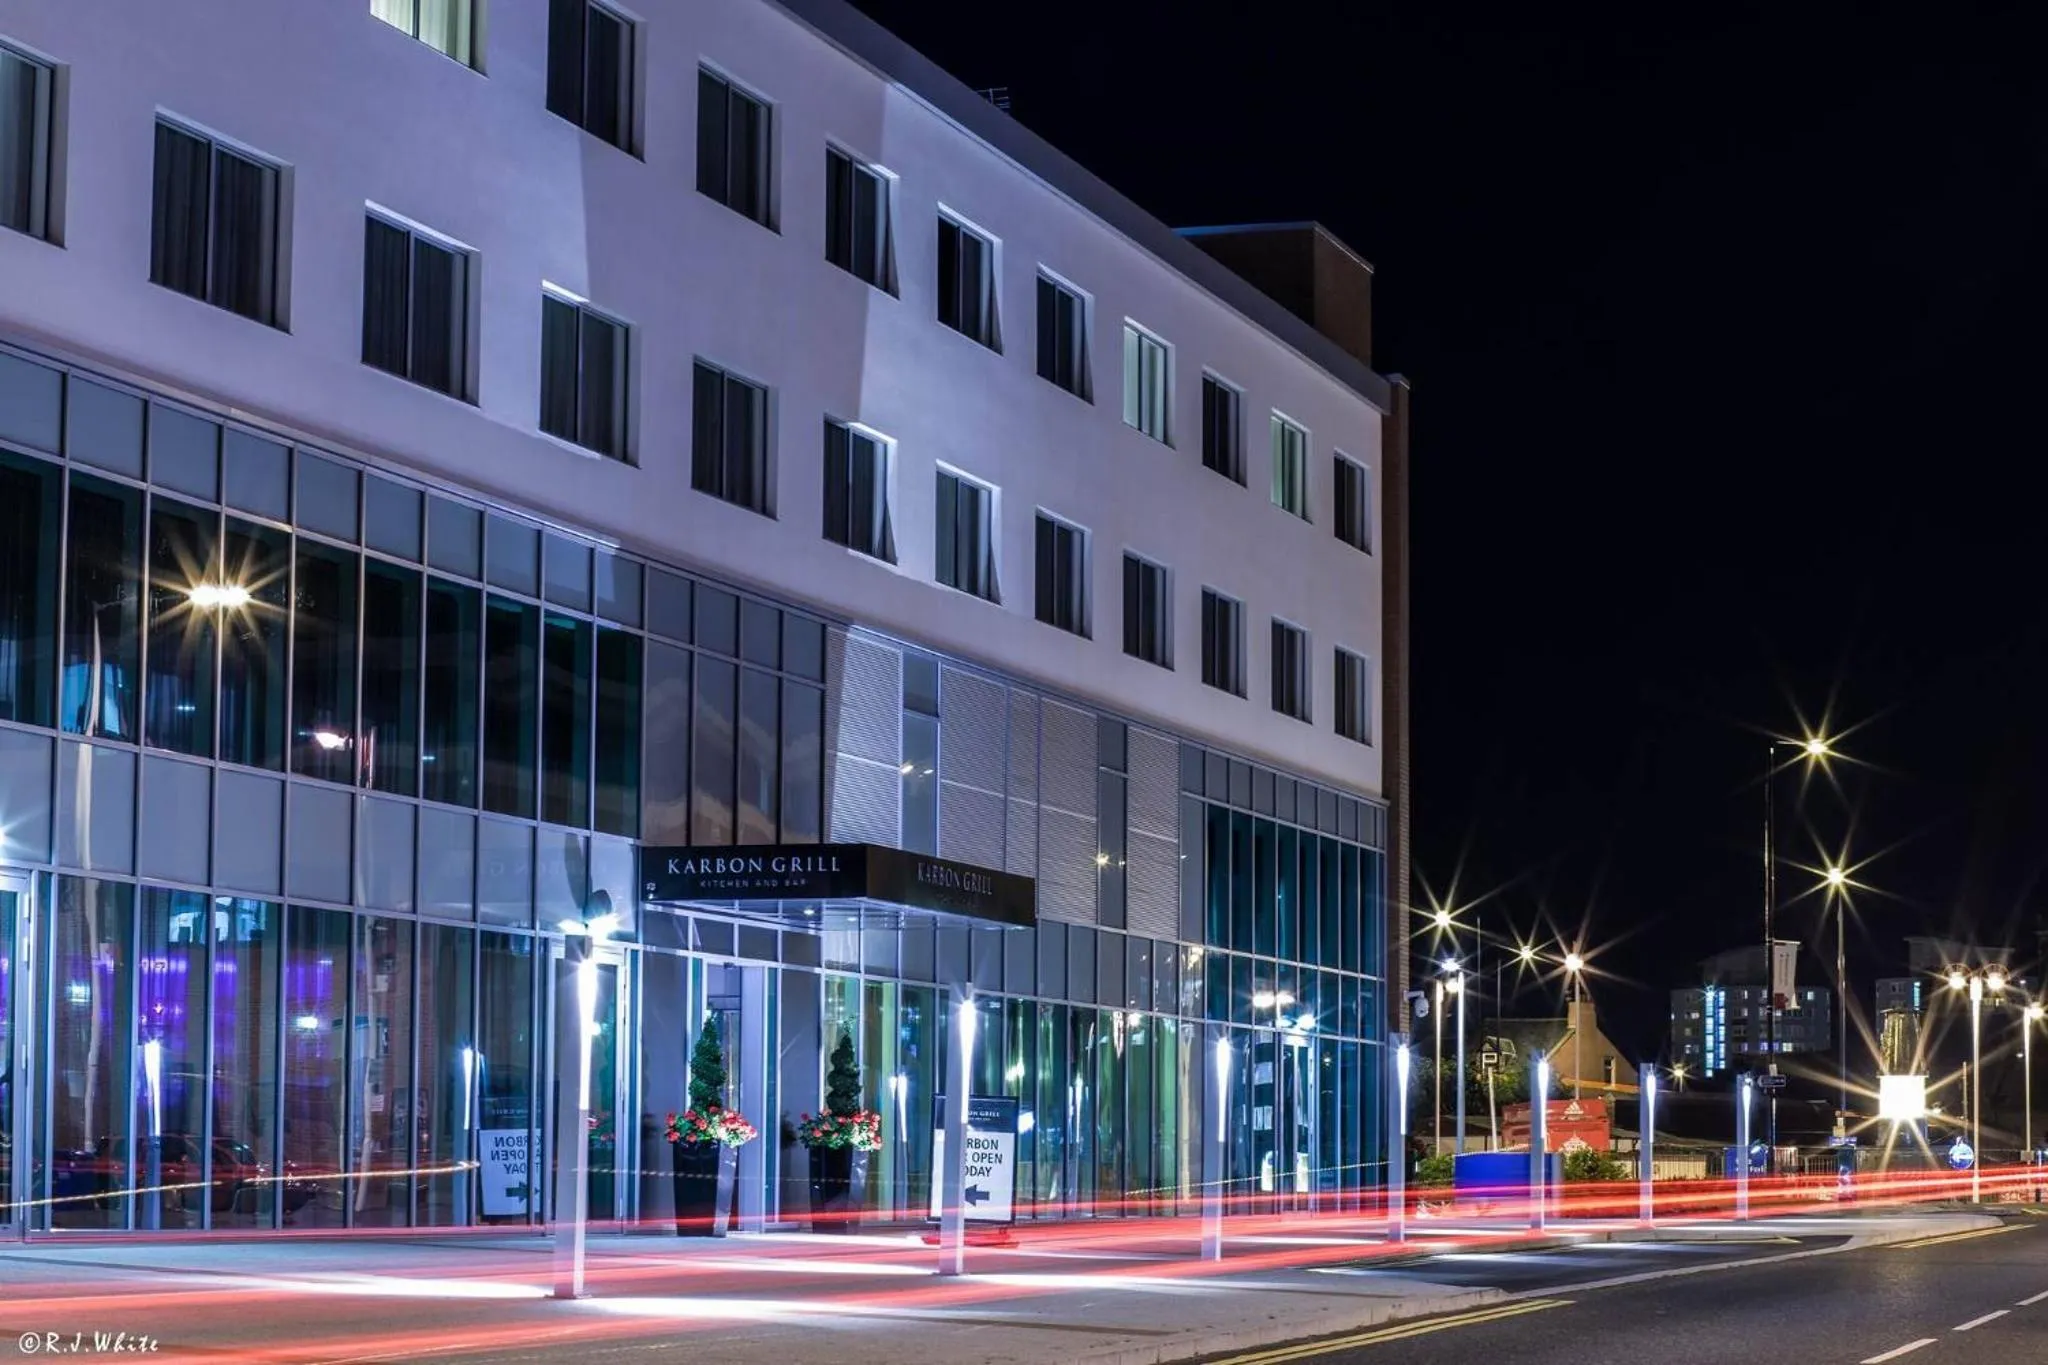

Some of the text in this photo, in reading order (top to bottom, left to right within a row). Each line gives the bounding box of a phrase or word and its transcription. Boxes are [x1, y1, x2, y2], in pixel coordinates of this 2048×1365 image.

[667, 856, 841, 875] KARBON GRILL
[700, 879, 807, 889] KITCHEN AND BAR
[917, 862, 993, 896] KARBON GRILL
[966, 1138, 999, 1150] RBON
[972, 1152, 1003, 1164] OPEN
